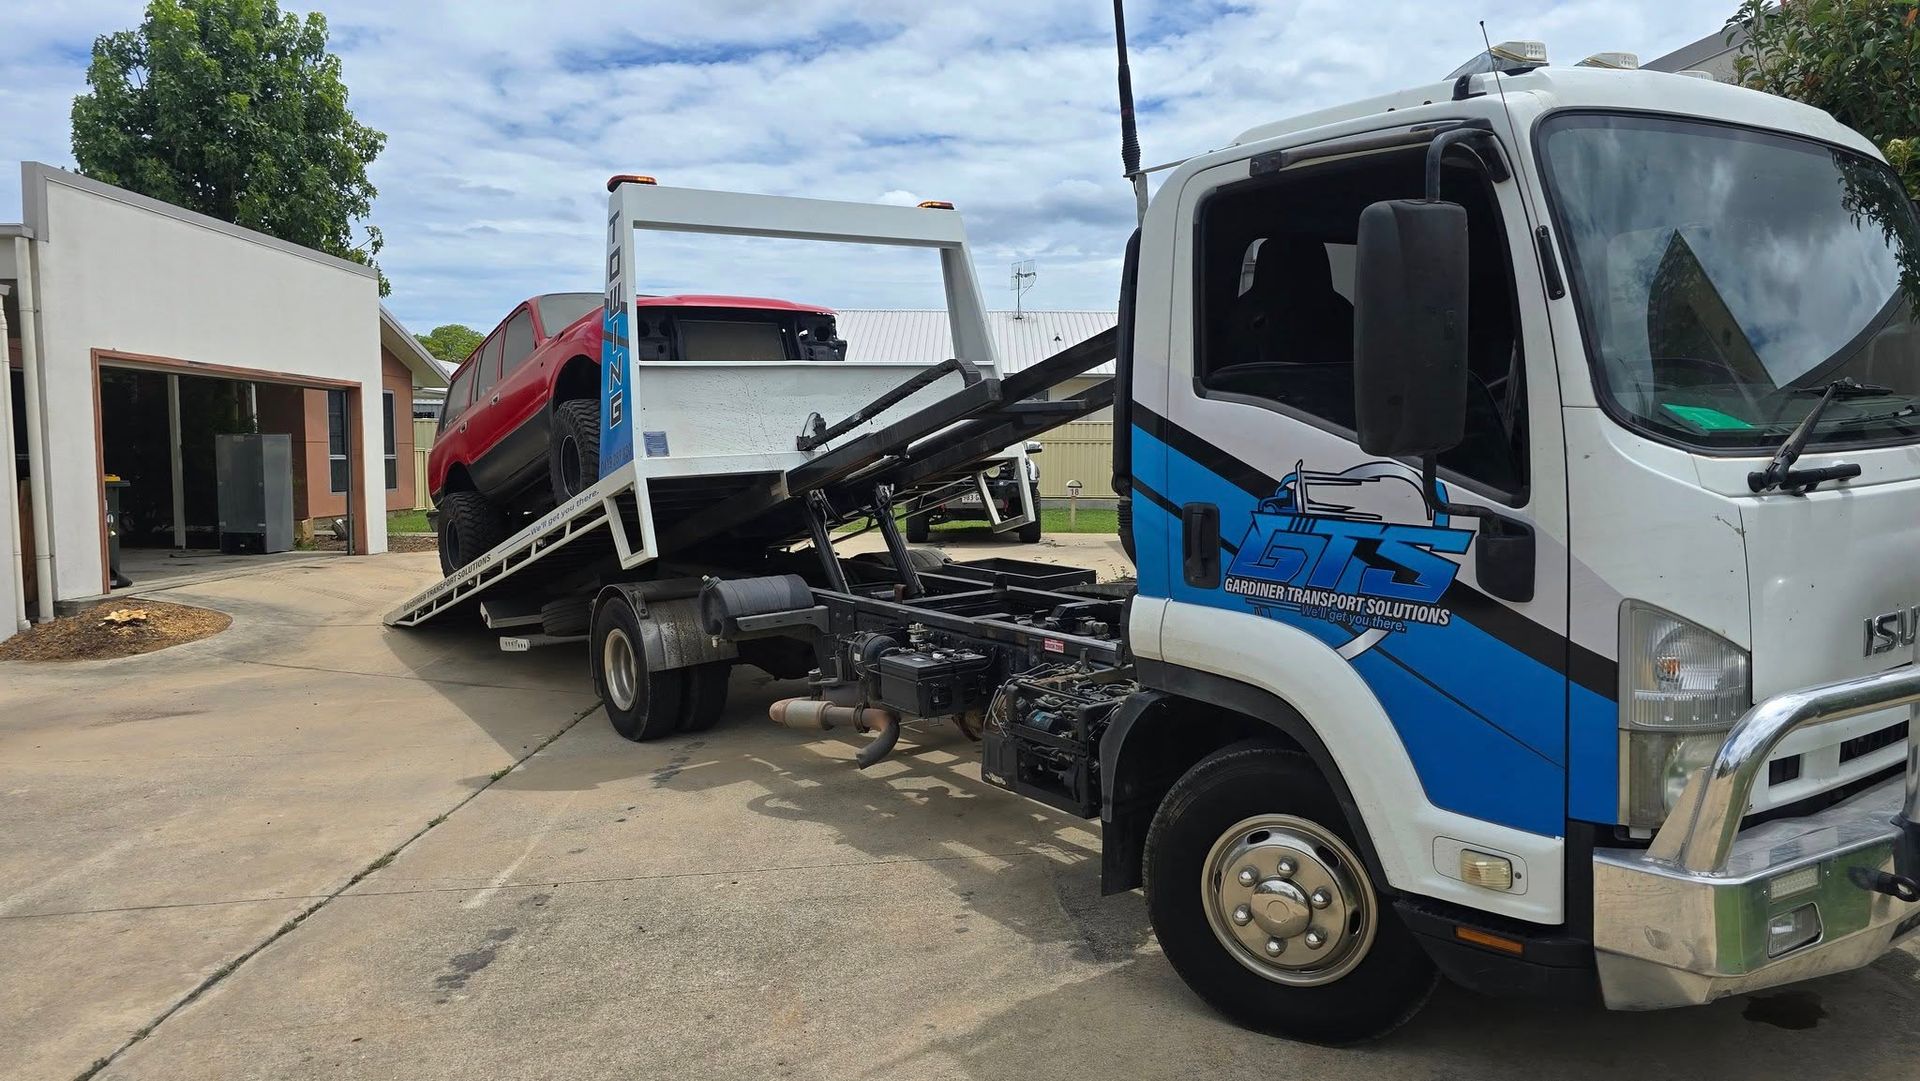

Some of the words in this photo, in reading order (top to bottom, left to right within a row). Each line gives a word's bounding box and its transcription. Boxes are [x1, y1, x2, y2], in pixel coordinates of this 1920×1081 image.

[608, 210, 622, 430] TOWING
[1070, 488, 1080, 496] 18
[547, 512, 560, 527] get
[560, 504, 575, 518] you
[427, 575, 457, 598] TRANSPORT
[457, 554, 491, 580] SOLUTIONS
[1226, 511, 1477, 603] GTS
[1224, 578, 1285, 600] GARDINER
[1287, 587, 1366, 612] TRANSPORT
[1366, 598, 1451, 625] SOLUTIONS
[1301, 604, 1327, 619] We'll
[1328, 611, 1349, 623] get
[1349, 613, 1370, 626] you
[1371, 616, 1406, 632] there.
